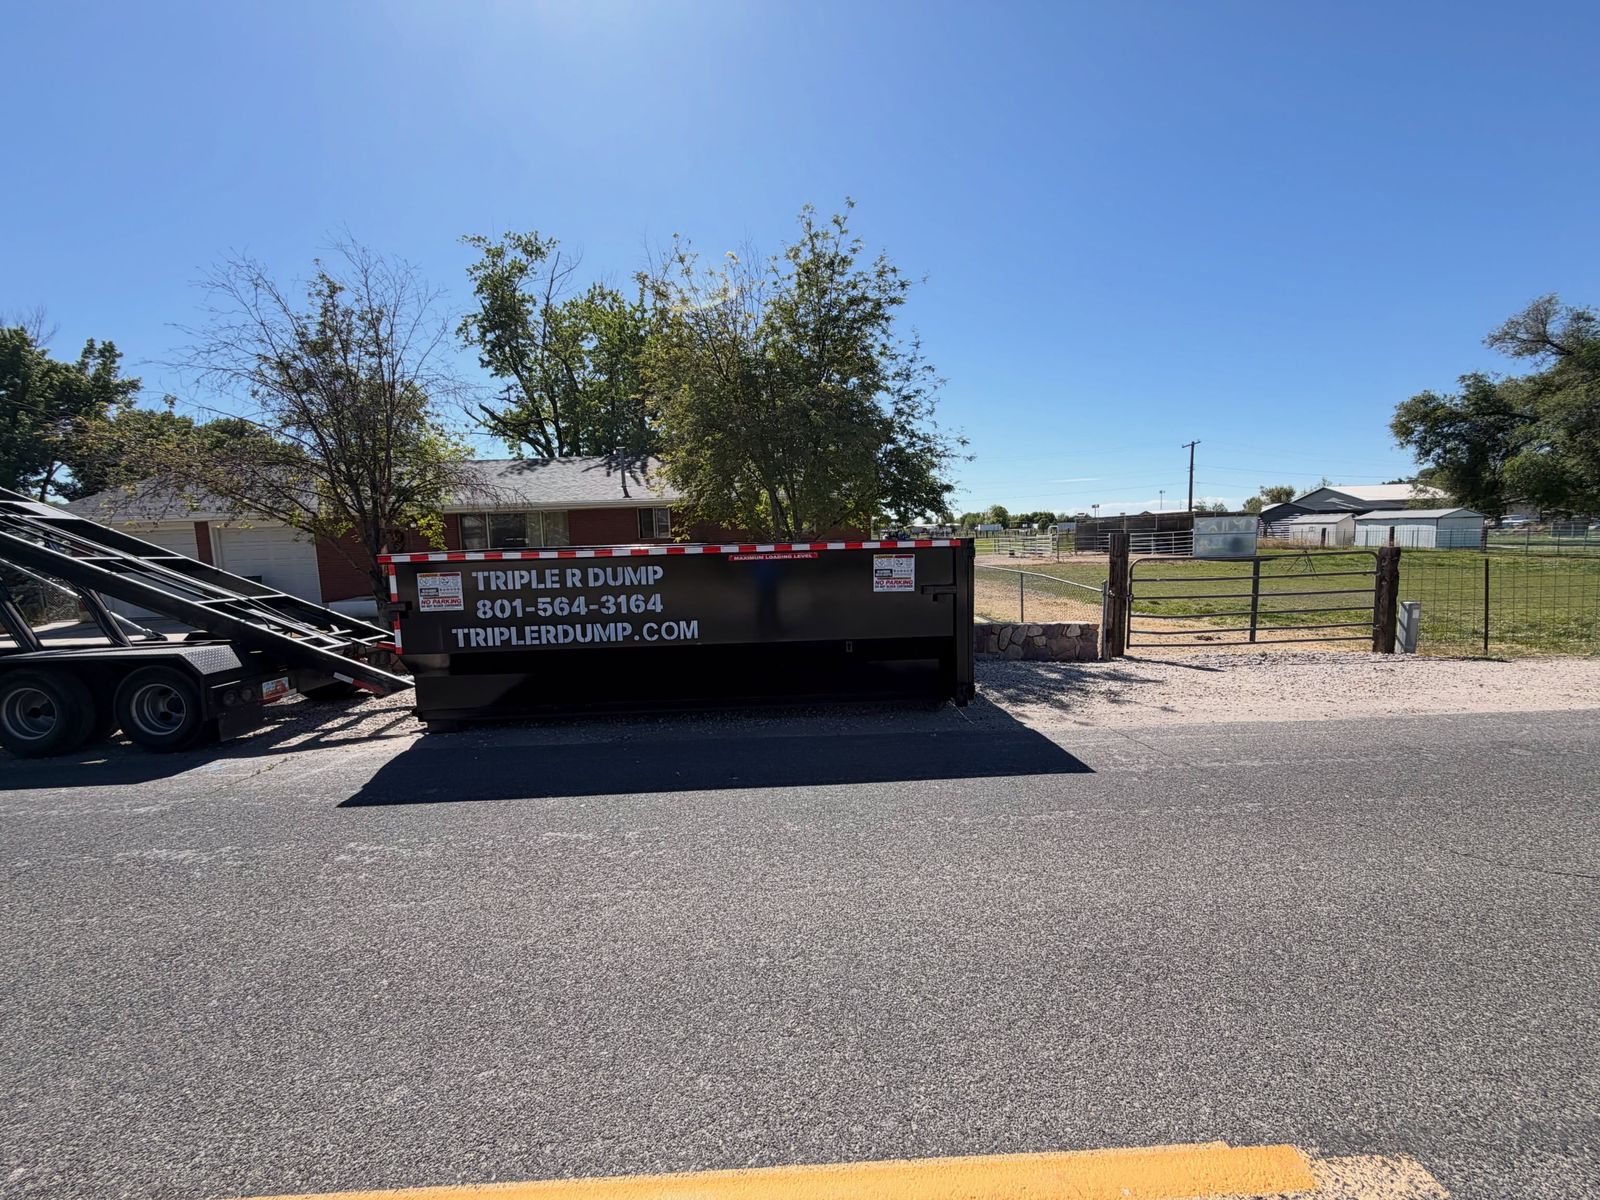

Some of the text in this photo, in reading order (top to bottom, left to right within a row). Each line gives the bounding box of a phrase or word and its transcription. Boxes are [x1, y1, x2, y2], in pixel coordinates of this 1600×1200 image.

[472, 569, 560, 591] TRIPLE
[566, 568, 583, 588] R
[588, 565, 664, 587] DUMP
[477, 593, 664, 619] 801-564-3164
[452, 620, 699, 648] TRIPLERDUMP.COM
